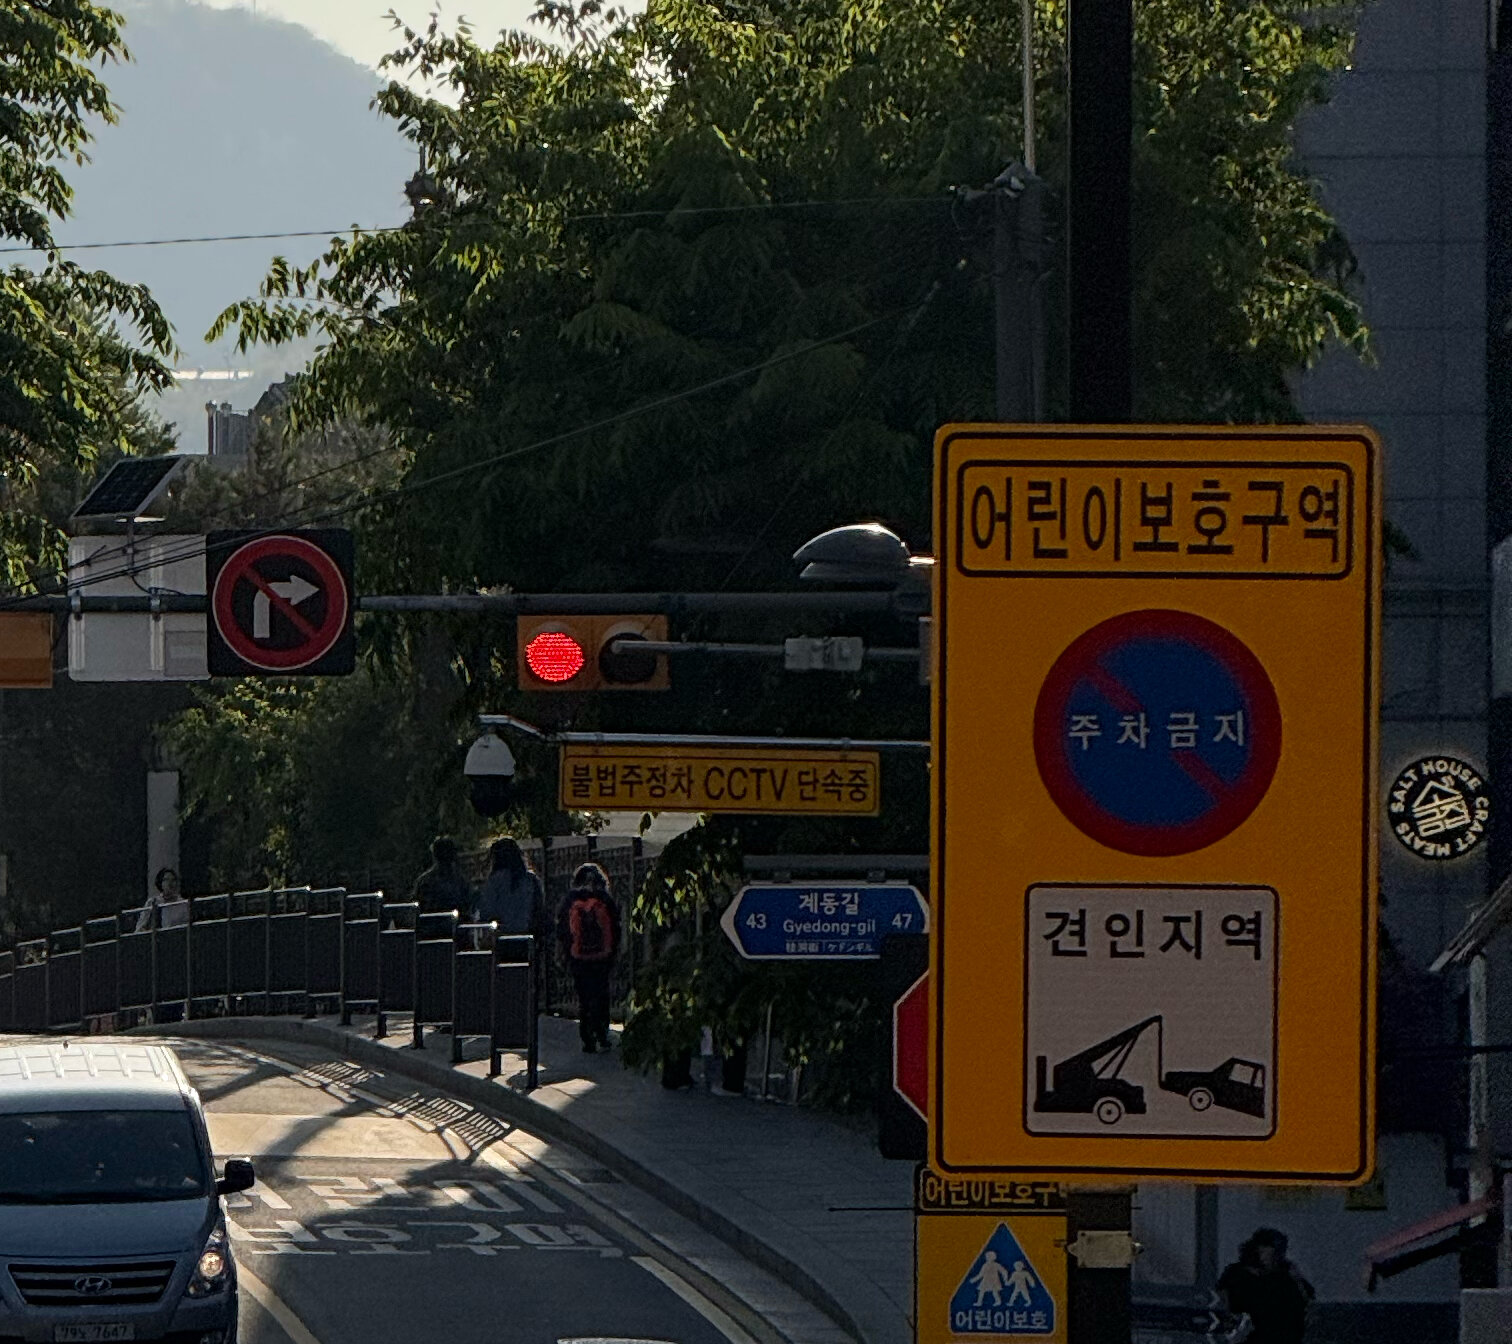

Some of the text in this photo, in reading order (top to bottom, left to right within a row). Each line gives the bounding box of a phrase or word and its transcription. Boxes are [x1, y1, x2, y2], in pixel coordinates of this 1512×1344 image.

[970, 477, 1341, 562] 어린이보호구역
[1068, 714, 1246, 750] 주차금지
[569, 764, 871, 802] 불법주정차 CCTV 단속중
[1390, 759, 1490, 857] SALT HOUSE CRAFT MEATS
[798, 892, 860, 916] 계동길
[745, 912, 768, 930] 43
[782, 918, 876, 936] Gyedong-gil
[891, 912, 913, 930] 47
[1041, 909, 1264, 961] 견인지역
[955, 1309, 1049, 1331] 어린이보호
